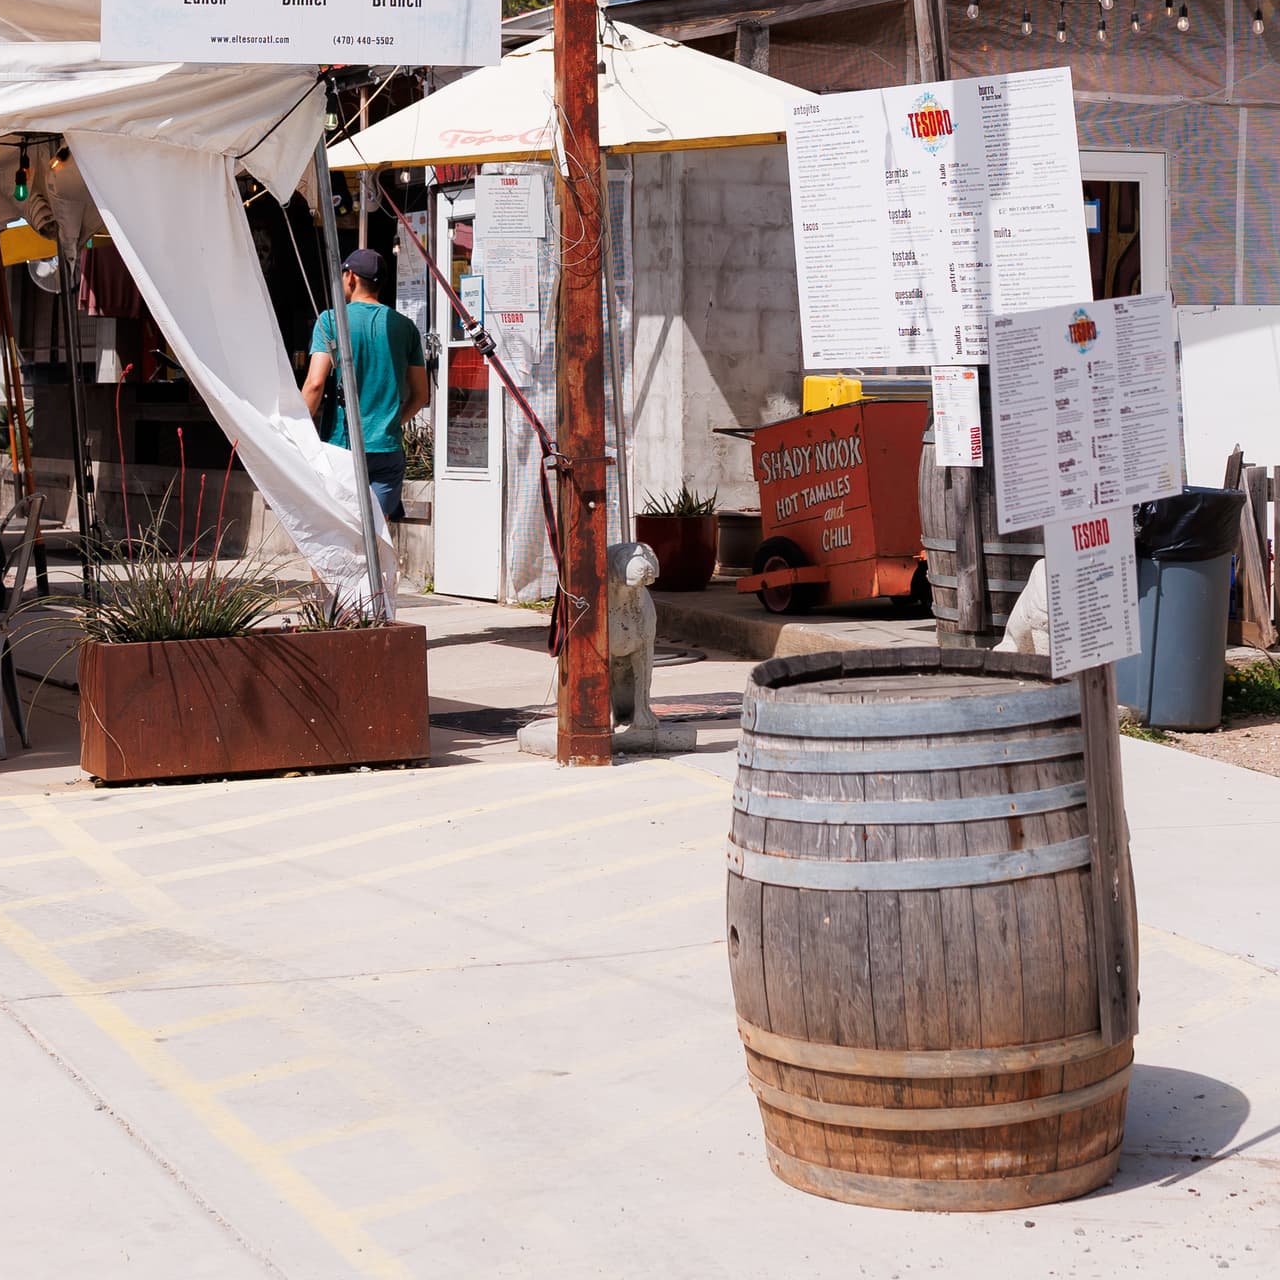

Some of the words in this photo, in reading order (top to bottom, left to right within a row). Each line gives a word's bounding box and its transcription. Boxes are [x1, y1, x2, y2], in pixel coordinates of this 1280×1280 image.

[210, 34, 290, 45] www.eltesoroatl.com
[332, 35, 354, 46] (470)
[357, 36, 394, 46] 440-5502
[793, 104, 820, 116] antojitos
[907, 108, 955, 138] TESORO
[949, 262, 958, 293] postres
[500, 313, 524, 324] TESORO
[970, 426, 982, 461] TESORO
[760, 444, 812, 485] SHADY
[814, 435, 863, 473] NOOK
[775, 491, 799, 521] HOT
[801, 475, 851, 509] TAMALES
[823, 501, 845, 522] and
[821, 524, 852, 552] CHILI
[1071, 518, 1110, 552] TESORO
